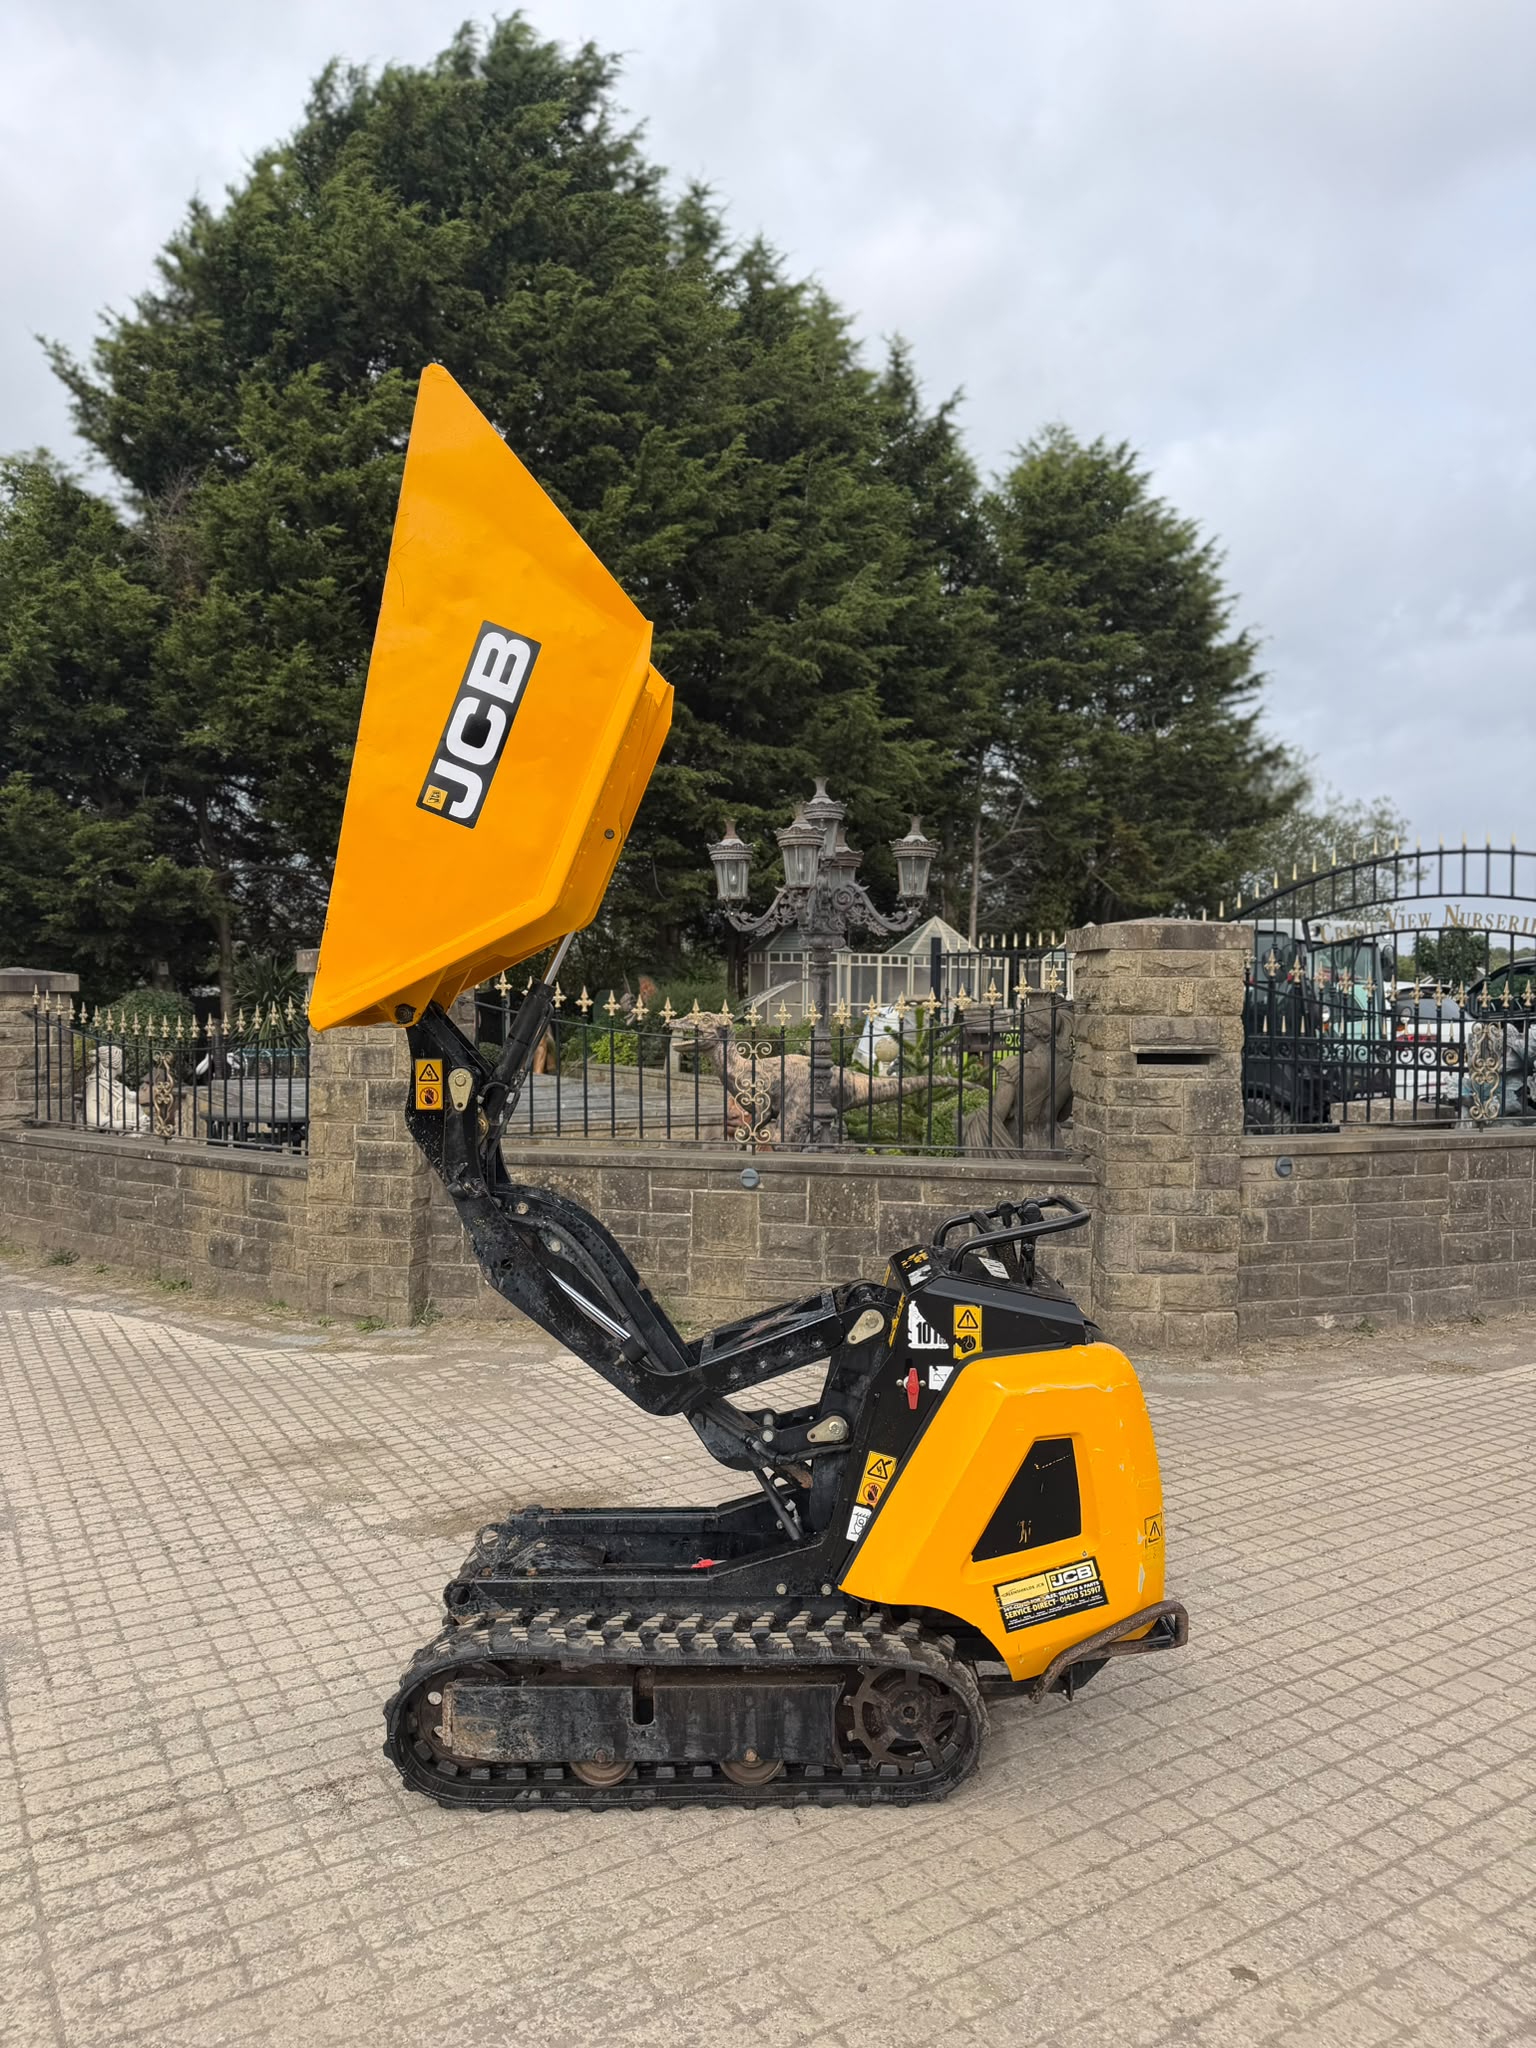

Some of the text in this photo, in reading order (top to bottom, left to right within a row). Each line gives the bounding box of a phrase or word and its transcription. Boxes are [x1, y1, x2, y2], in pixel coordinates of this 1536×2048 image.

[434, 632, 531, 819] JCB
[1385, 908, 1432, 930] VIEW
[1052, 1566, 1092, 1586] JCB
